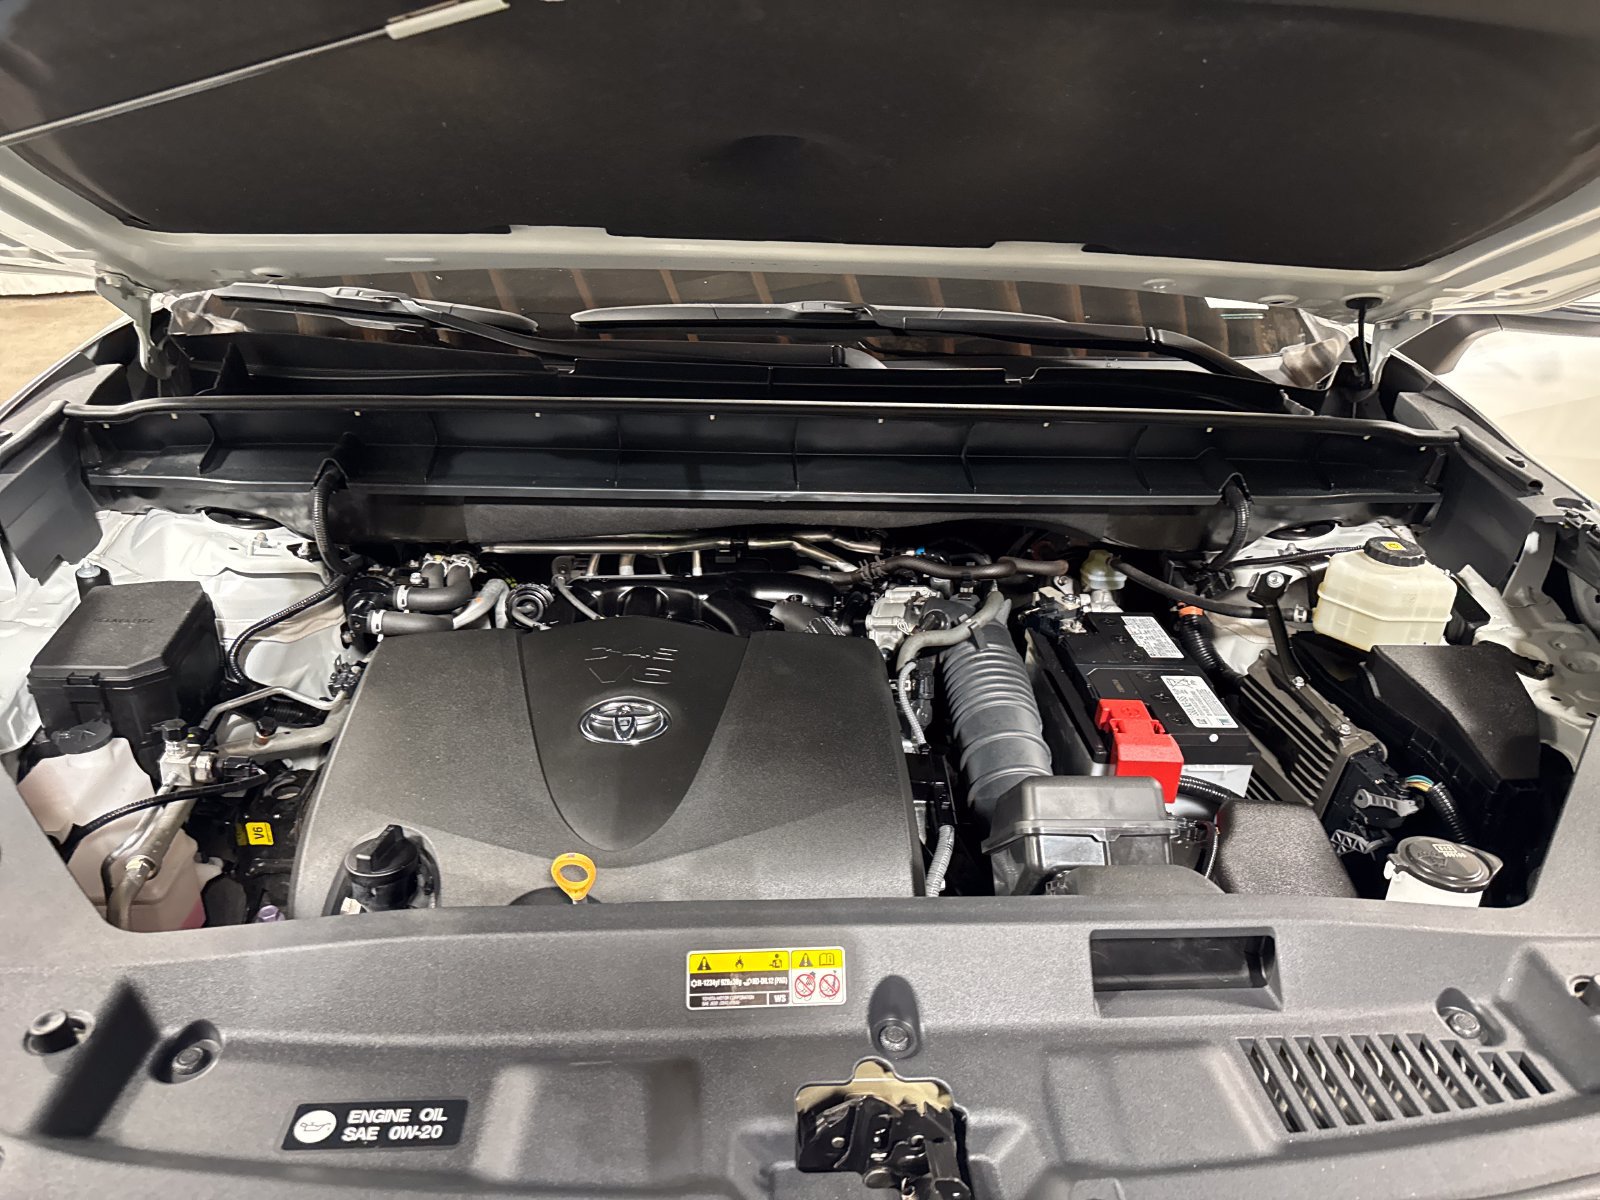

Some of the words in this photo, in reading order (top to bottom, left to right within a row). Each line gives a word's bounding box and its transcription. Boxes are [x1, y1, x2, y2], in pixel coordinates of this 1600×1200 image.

[252, 826, 264, 840] V6
[774, 995, 786, 1003] WS
[347, 1108, 412, 1124] ENGINE
[419, 1107, 448, 1122] OIL
[341, 1126, 380, 1141] SAE
[388, 1125, 443, 1140] 0W-20
